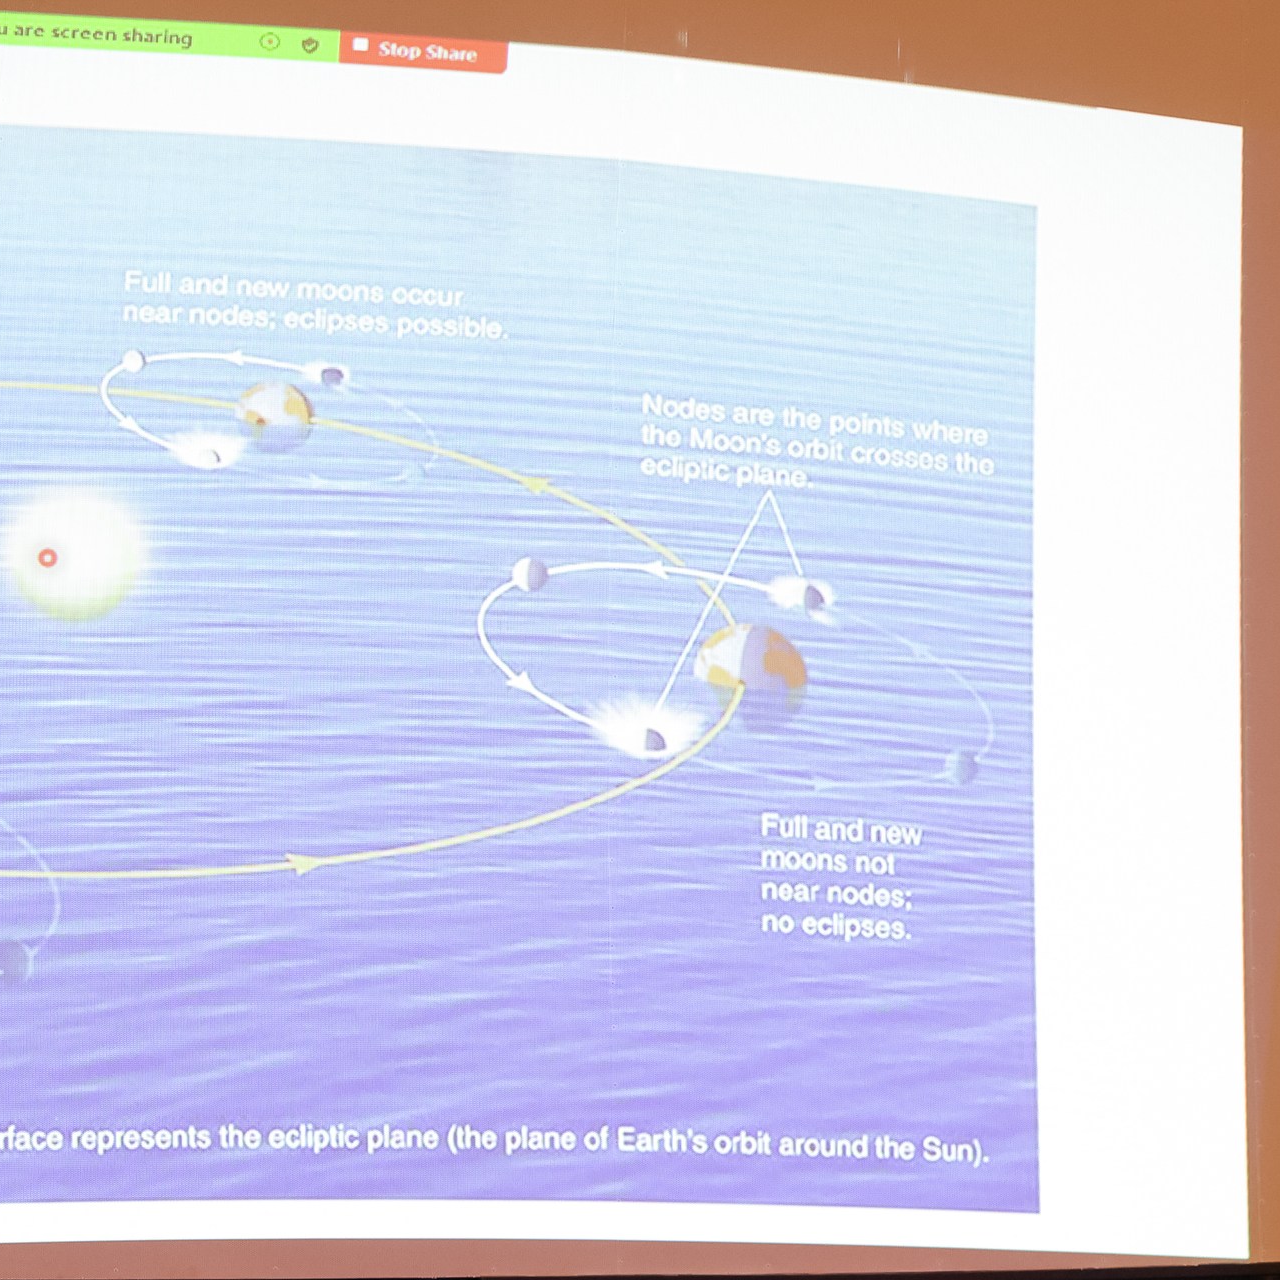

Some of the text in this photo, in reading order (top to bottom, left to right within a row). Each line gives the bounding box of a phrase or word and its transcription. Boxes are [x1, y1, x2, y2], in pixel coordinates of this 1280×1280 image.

[14, 25, 45, 40] are
[52, 25, 116, 43] screen
[122, 27, 192, 49] sharing
[379, 41, 477, 64] Stop Share
[124, 270, 464, 307] Full and new moons occur
[122, 303, 509, 341] near nodes; eclipses possible.
[641, 392, 989, 447] Nodes are the points where
[641, 423, 994, 476] the Moon's orbit crosses the
[640, 455, 815, 489] ecliptic plane.
[760, 812, 923, 846] Full and new
[760, 849, 896, 876] moons not
[761, 880, 913, 911] near nodes;
[761, 912, 912, 942] no eclipses.
[70, 1125, 212, 1155] represents
[219, 1123, 261, 1150] the
[268, 1123, 360, 1153] ecliptic
[367, 1124, 439, 1153] plane
[447, 1125, 497, 1155] (the
[505, 1125, 576, 1155] plane
[584, 1125, 610, 1151] of
[618, 1126, 708, 1154] Earth's
[714, 1129, 772, 1157] orbit
[778, 1132, 868, 1158] around
[874, 1135, 915, 1161] the
[922, 1136, 990, 1167] Sun).
